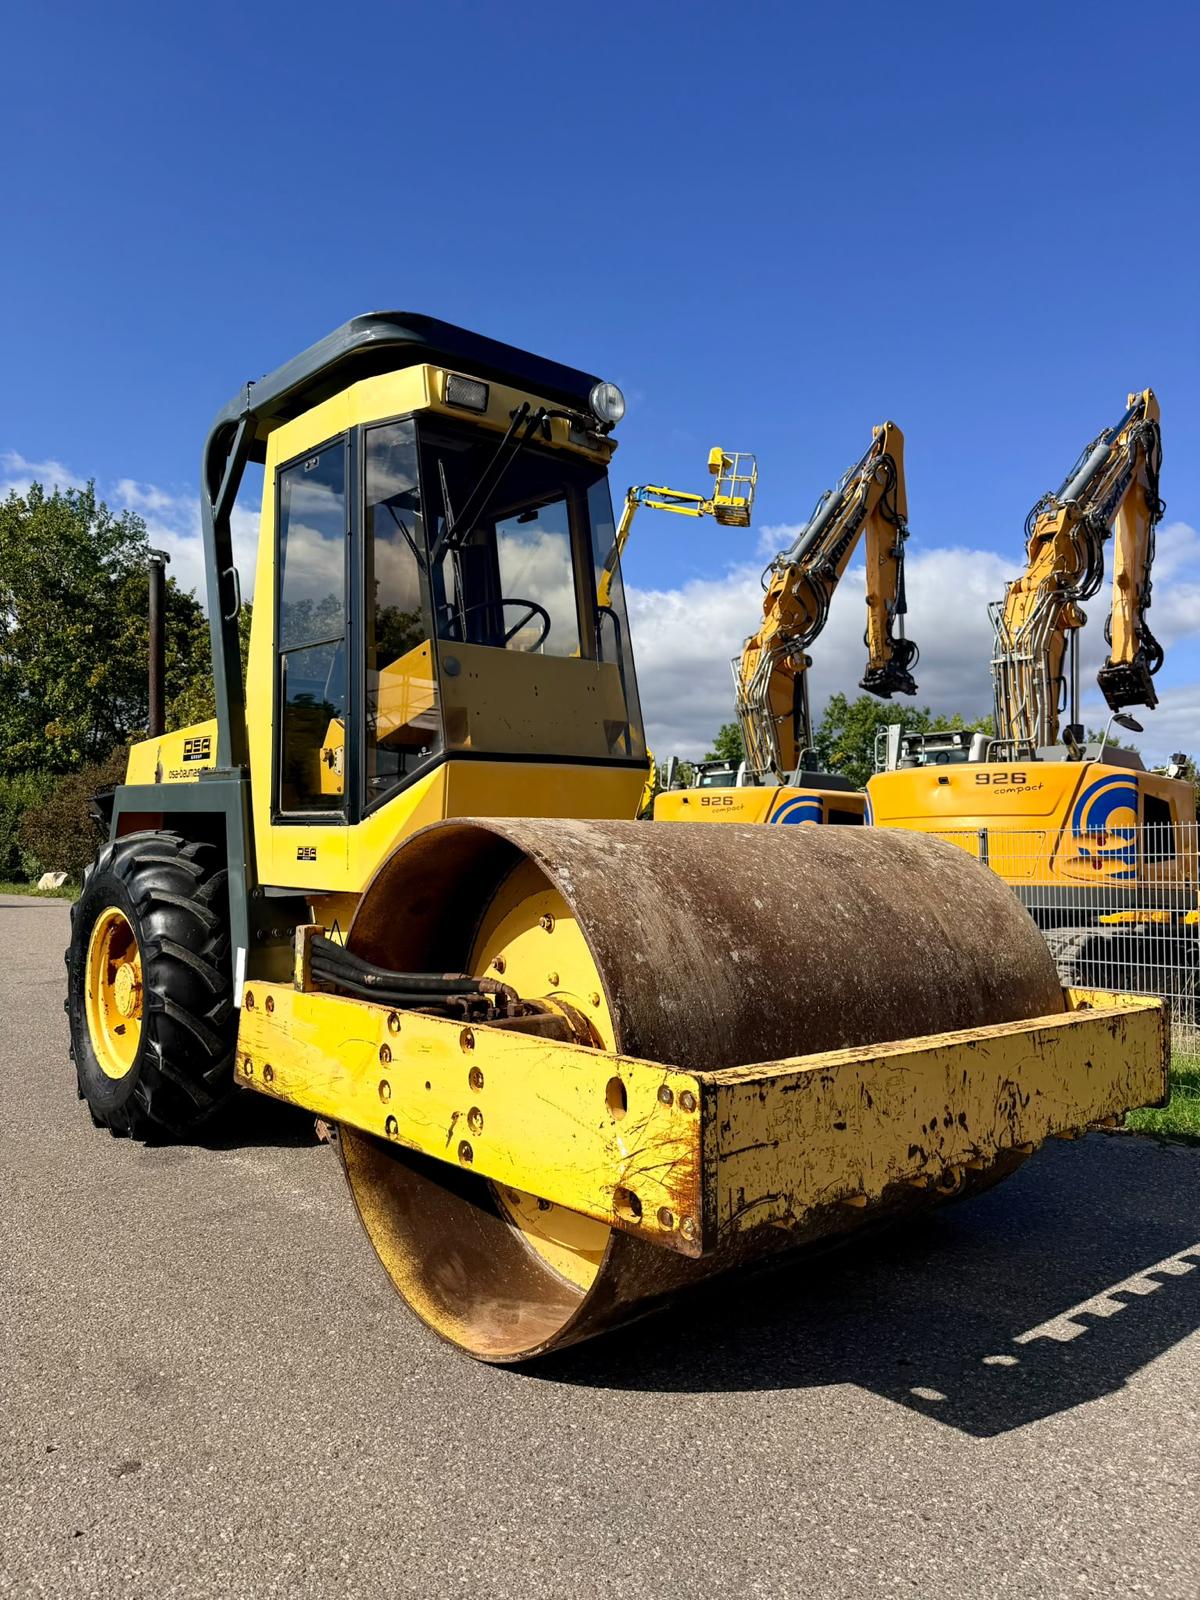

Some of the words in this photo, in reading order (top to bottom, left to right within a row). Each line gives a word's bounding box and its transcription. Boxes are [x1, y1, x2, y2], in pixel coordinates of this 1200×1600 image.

[974, 772, 1027, 785] 926
[993, 782, 1045, 795] compact
[701, 796, 734, 807] 926
[711, 803, 745, 814] compact
